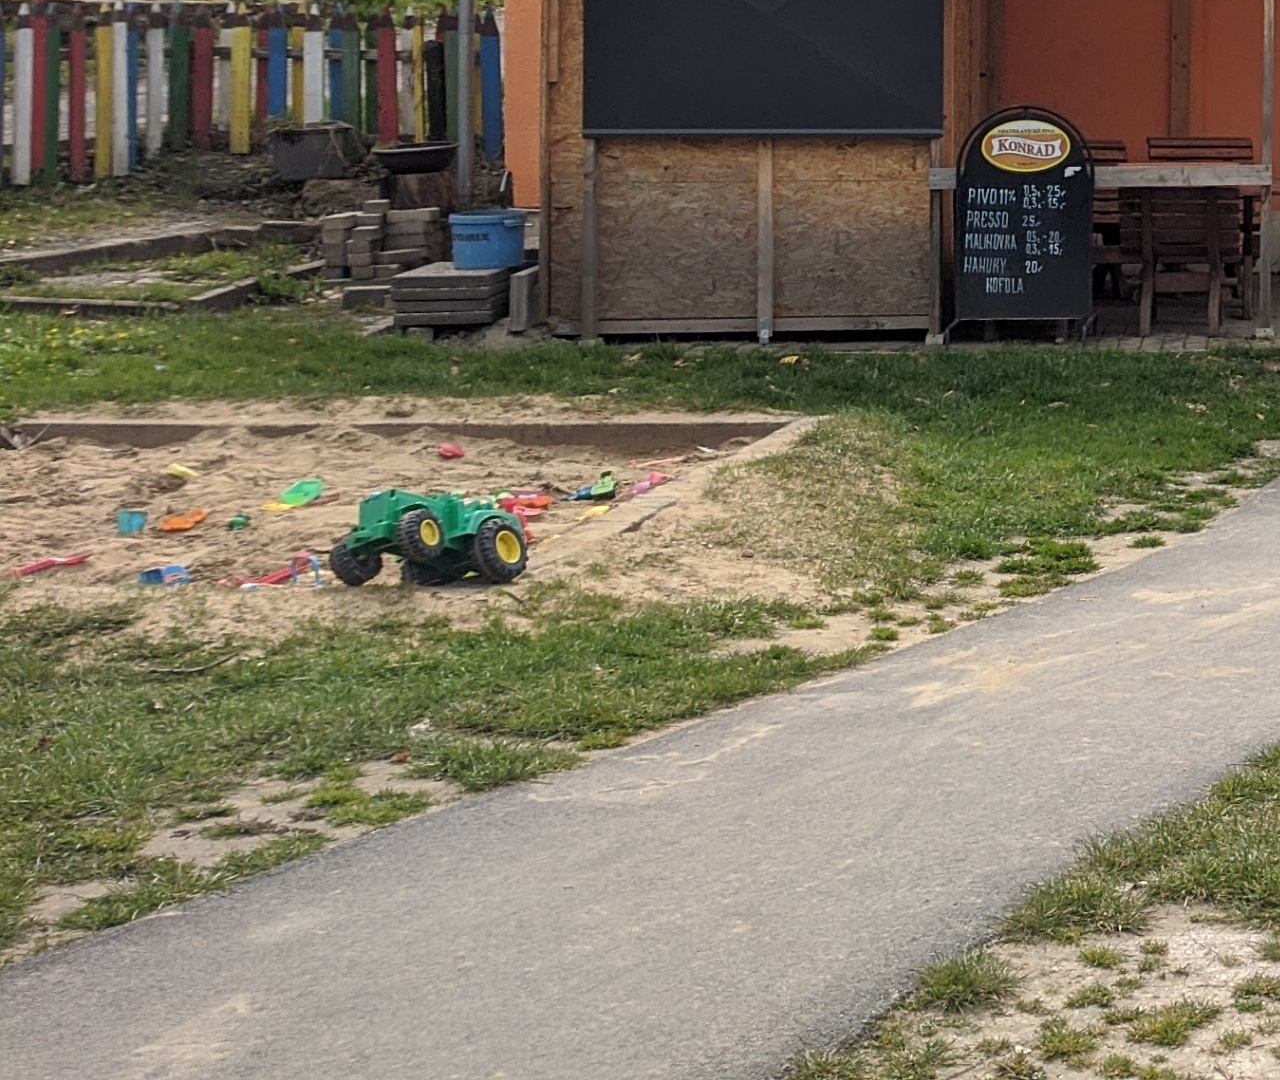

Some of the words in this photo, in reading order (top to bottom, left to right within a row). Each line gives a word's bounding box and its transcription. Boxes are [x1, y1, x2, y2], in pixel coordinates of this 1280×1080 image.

[997, 138, 1056, 157] KONRAD
[968, 187, 998, 205] PIVO
[966, 210, 1009, 229] PRESSO
[965, 232, 1018, 251] MALINOVKA
